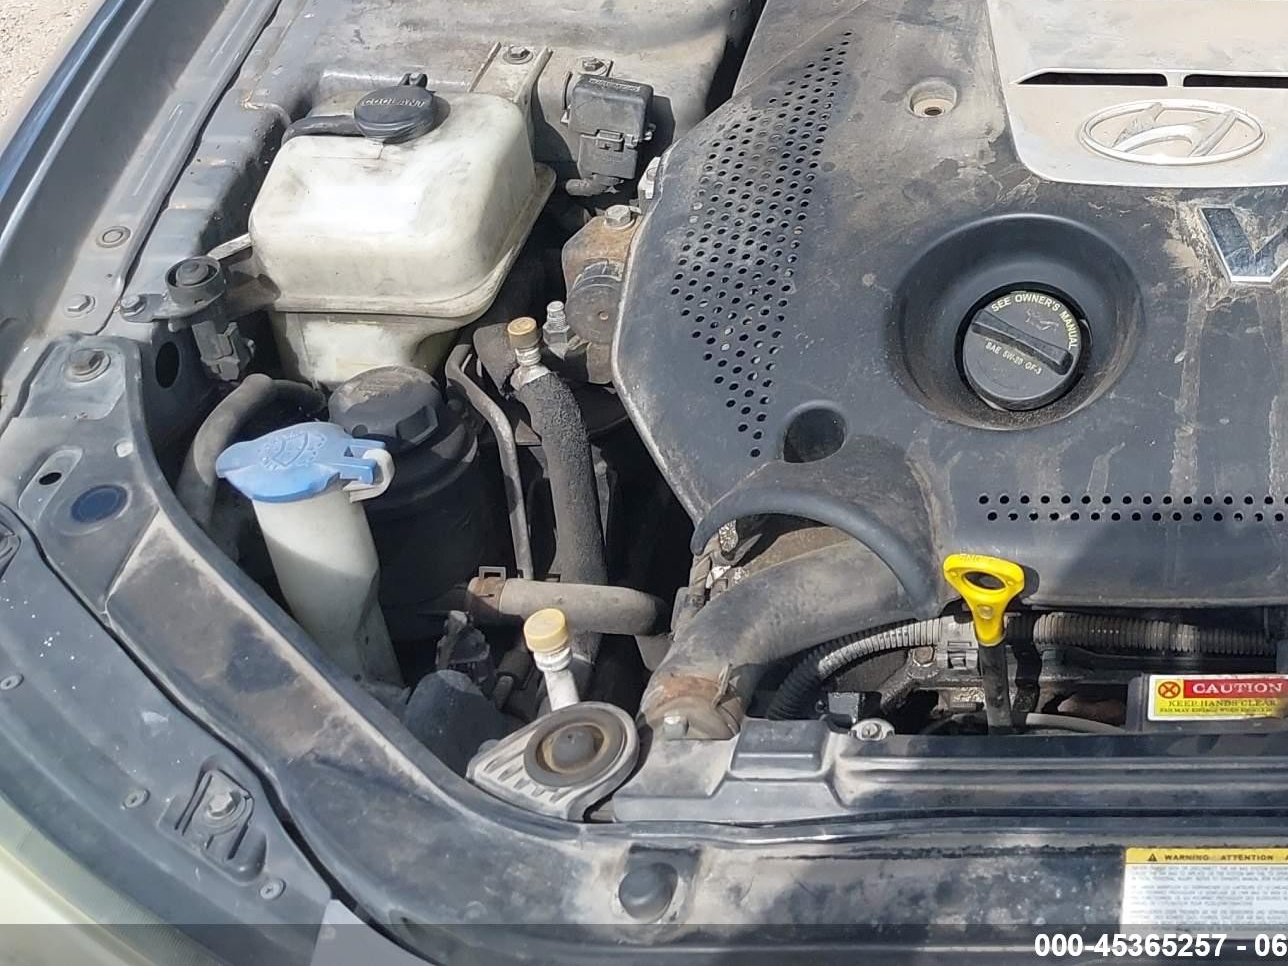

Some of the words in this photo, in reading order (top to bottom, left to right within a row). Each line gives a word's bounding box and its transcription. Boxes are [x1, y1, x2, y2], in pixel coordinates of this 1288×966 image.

[361, 97, 426, 108] COOLANT
[991, 298, 1012, 312] SEE
[1015, 294, 1061, 311] OWNER'S
[1059, 310, 1080, 350] MANUAL
[985, 341, 1002, 355] SAE
[1024, 360, 1043, 376] GF-3
[1192, 682, 1282, 694] CAUTION
[1168, 698, 1197, 707] KEEP
[1200, 698, 1238, 707] HANDS
[1241, 698, 1277, 707] CLEAR
[1164, 854, 1209, 862] WARNING
[1221, 854, 1274, 862] ATTENTION
